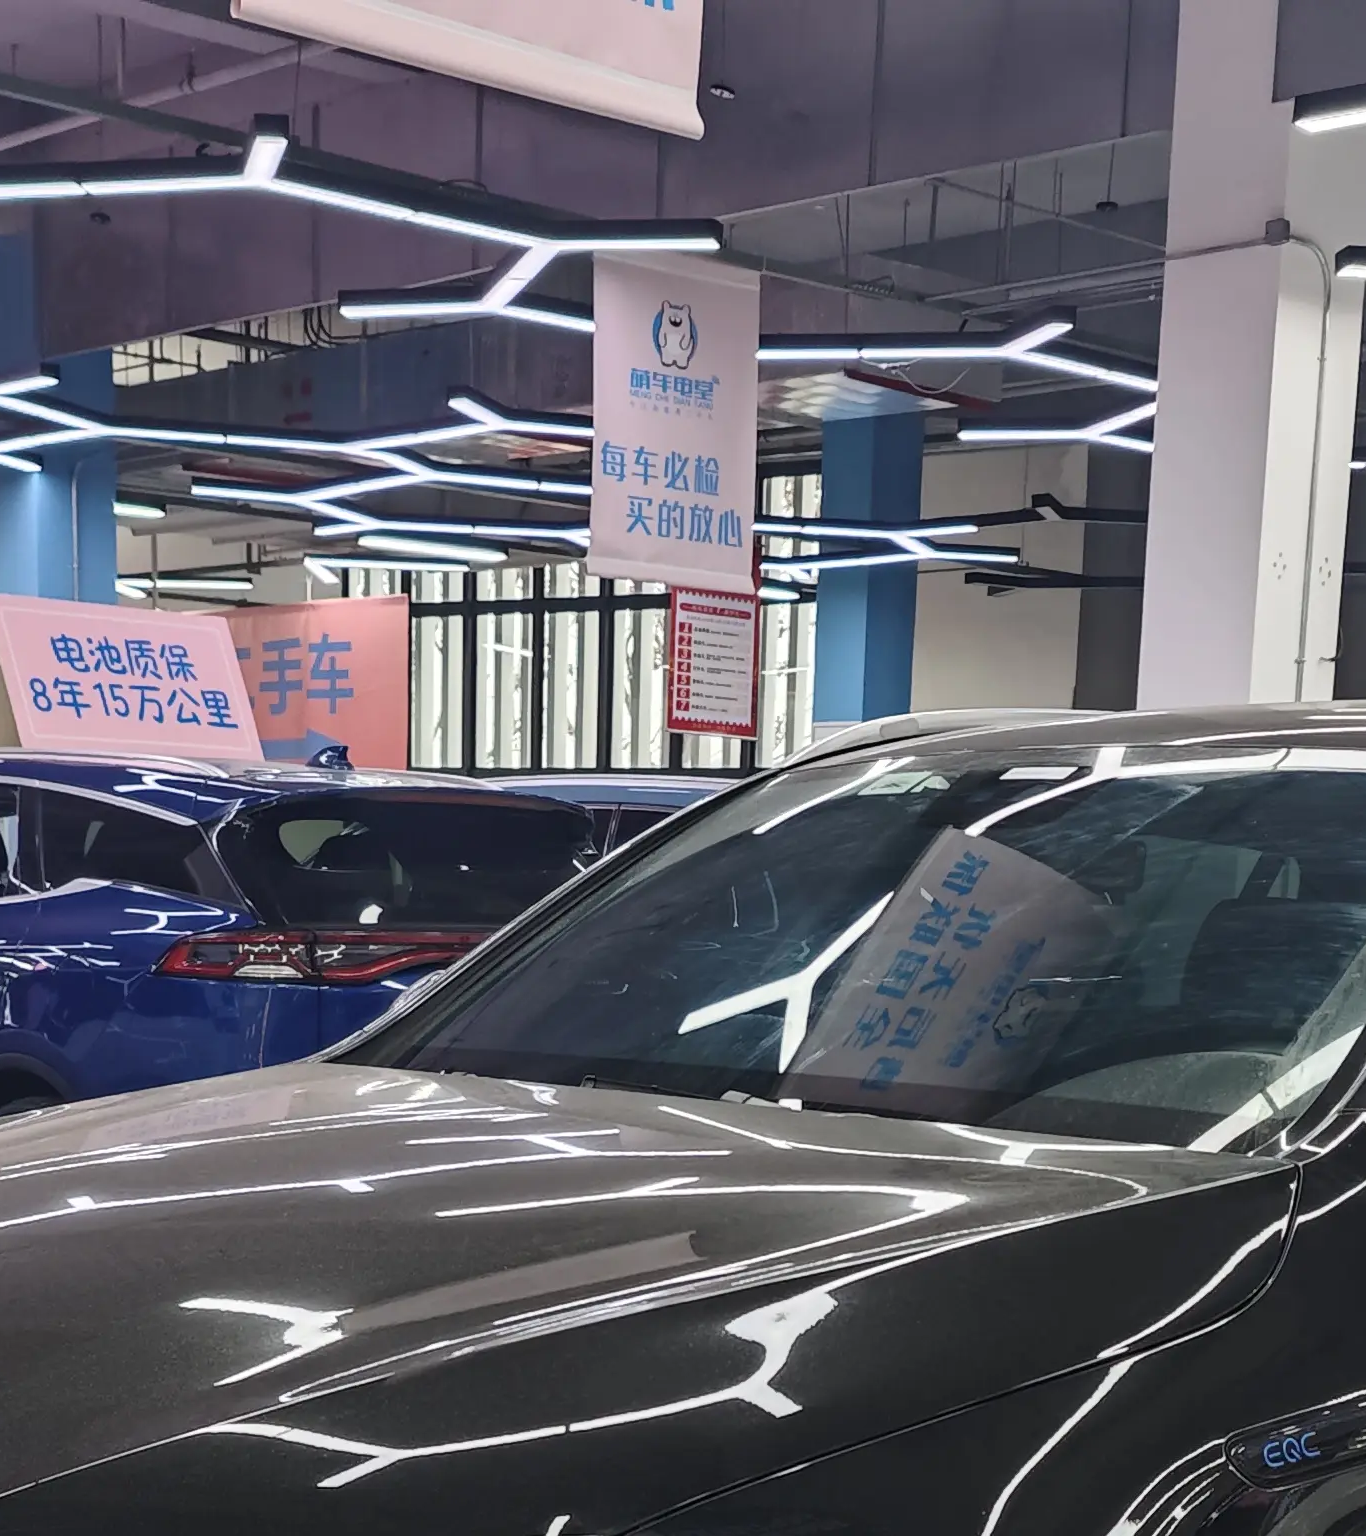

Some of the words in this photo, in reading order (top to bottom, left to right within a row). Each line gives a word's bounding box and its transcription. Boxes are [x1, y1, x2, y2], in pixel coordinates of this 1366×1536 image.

[599, 440, 720, 497] 每车必检
[625, 493, 744, 549] 买的放心
[50, 633, 198, 683] 电池质保
[29, 676, 239, 729] 8年15万公里
[1263, 1431, 1321, 1468] EQC
